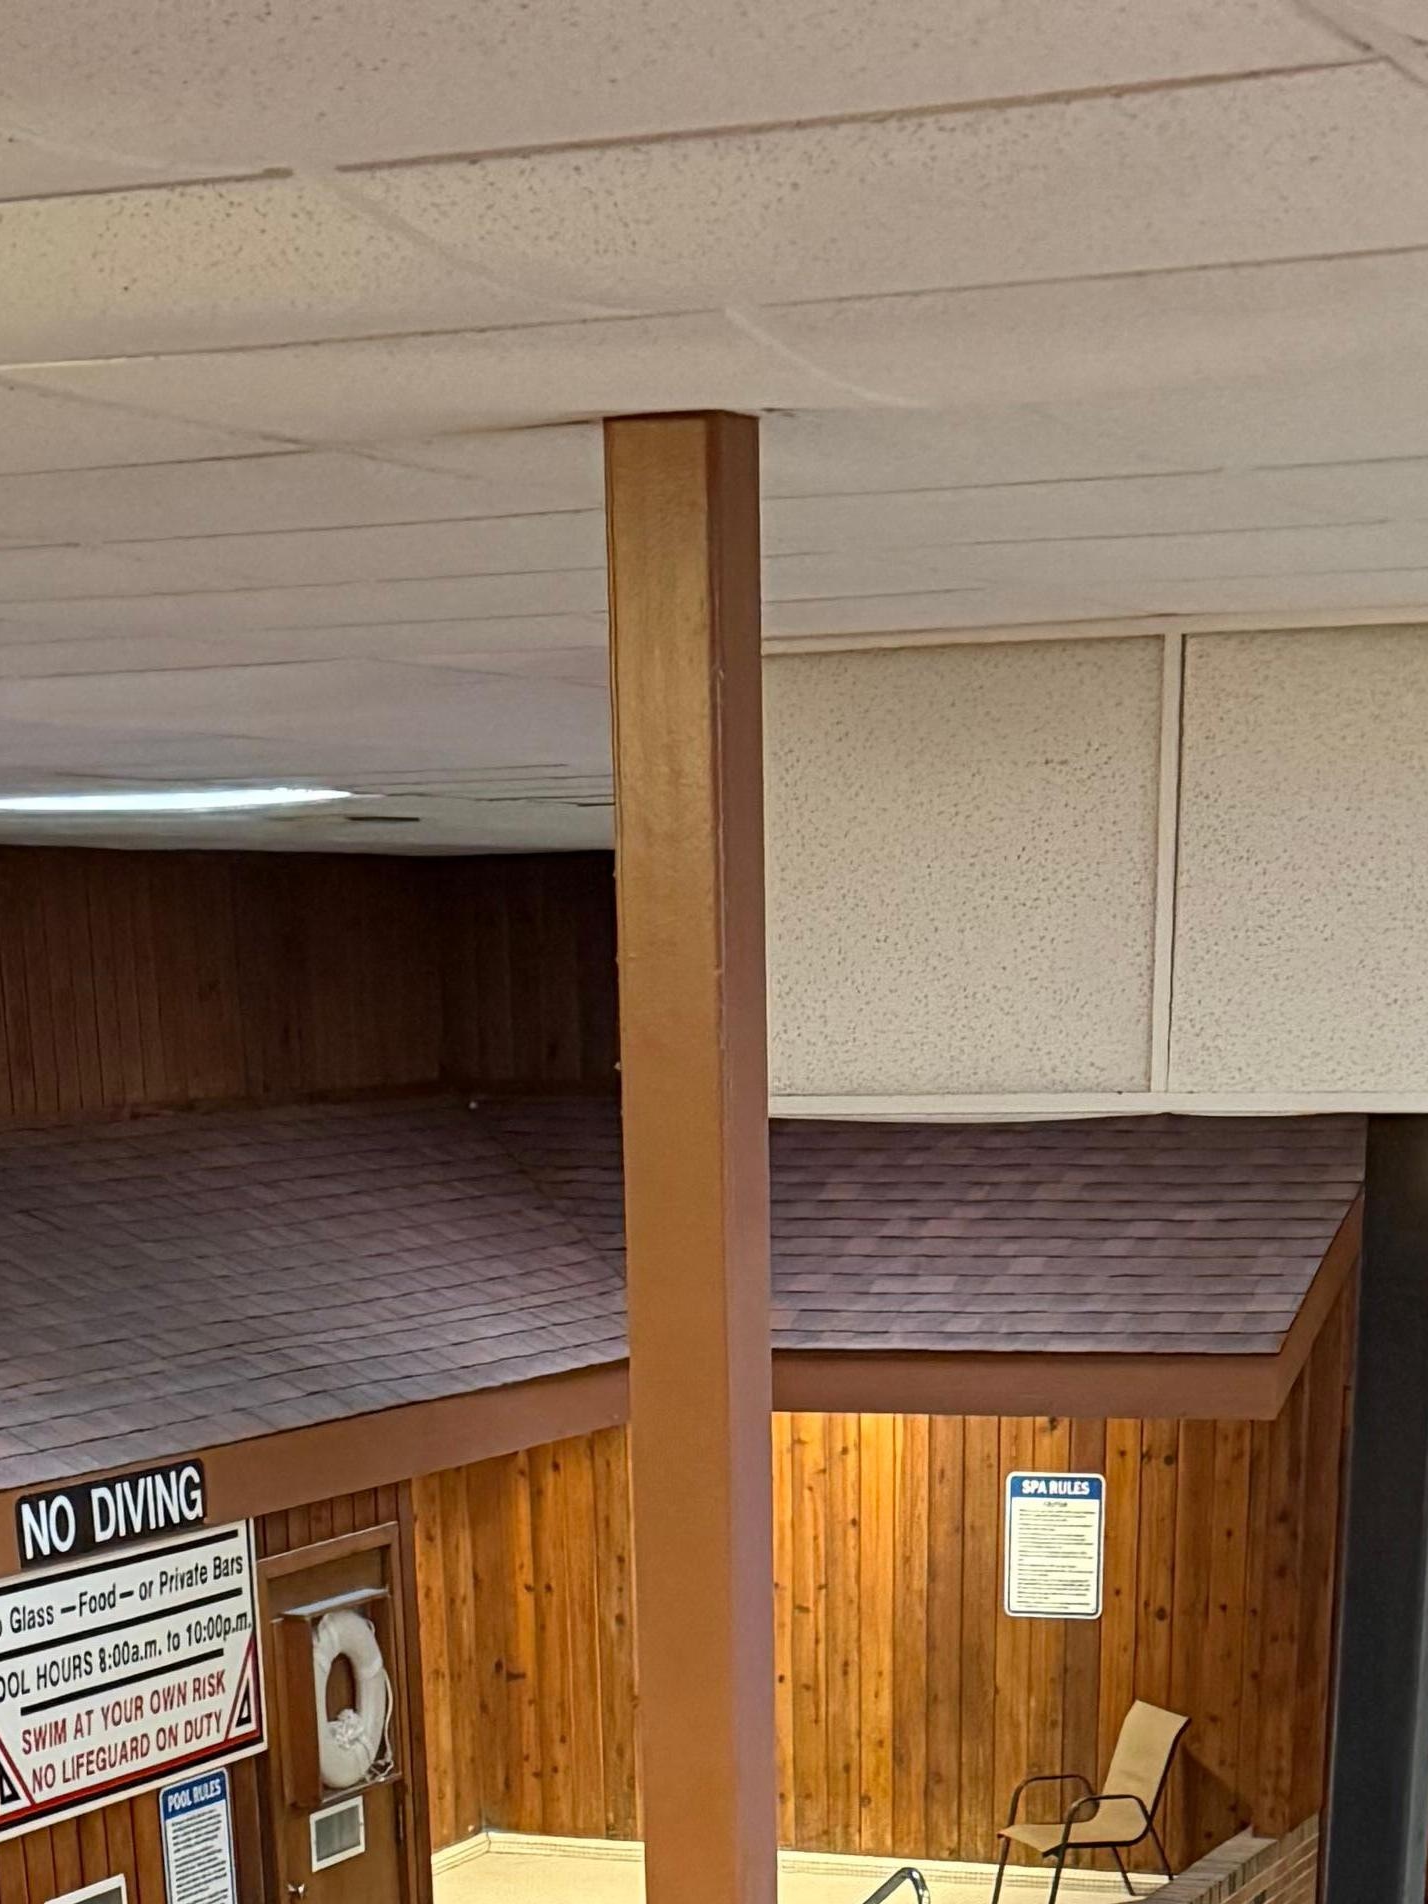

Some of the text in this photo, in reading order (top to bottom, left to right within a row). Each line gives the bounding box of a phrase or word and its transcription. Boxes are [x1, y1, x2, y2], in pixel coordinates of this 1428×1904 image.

[21, 1465, 205, 1560] NO DIVING
[1021, 1479, 1090, 1496] SPA RULES
[9, 1603, 54, 1634] Glass
[138, 1579, 154, 1601] or
[159, 1560, 208, 1596] Private
[212, 1554, 244, 1581] Bars
[36, 1650, 93, 1690] HOURS
[166, 1630, 181, 1654] to
[21, 1668, 227, 1755] SWIM AT YOUR OWN RISK
[31, 1708, 223, 1795] NO LIFEGUARD ON DUTY
[167, 1778, 222, 1813] POOL RULES
